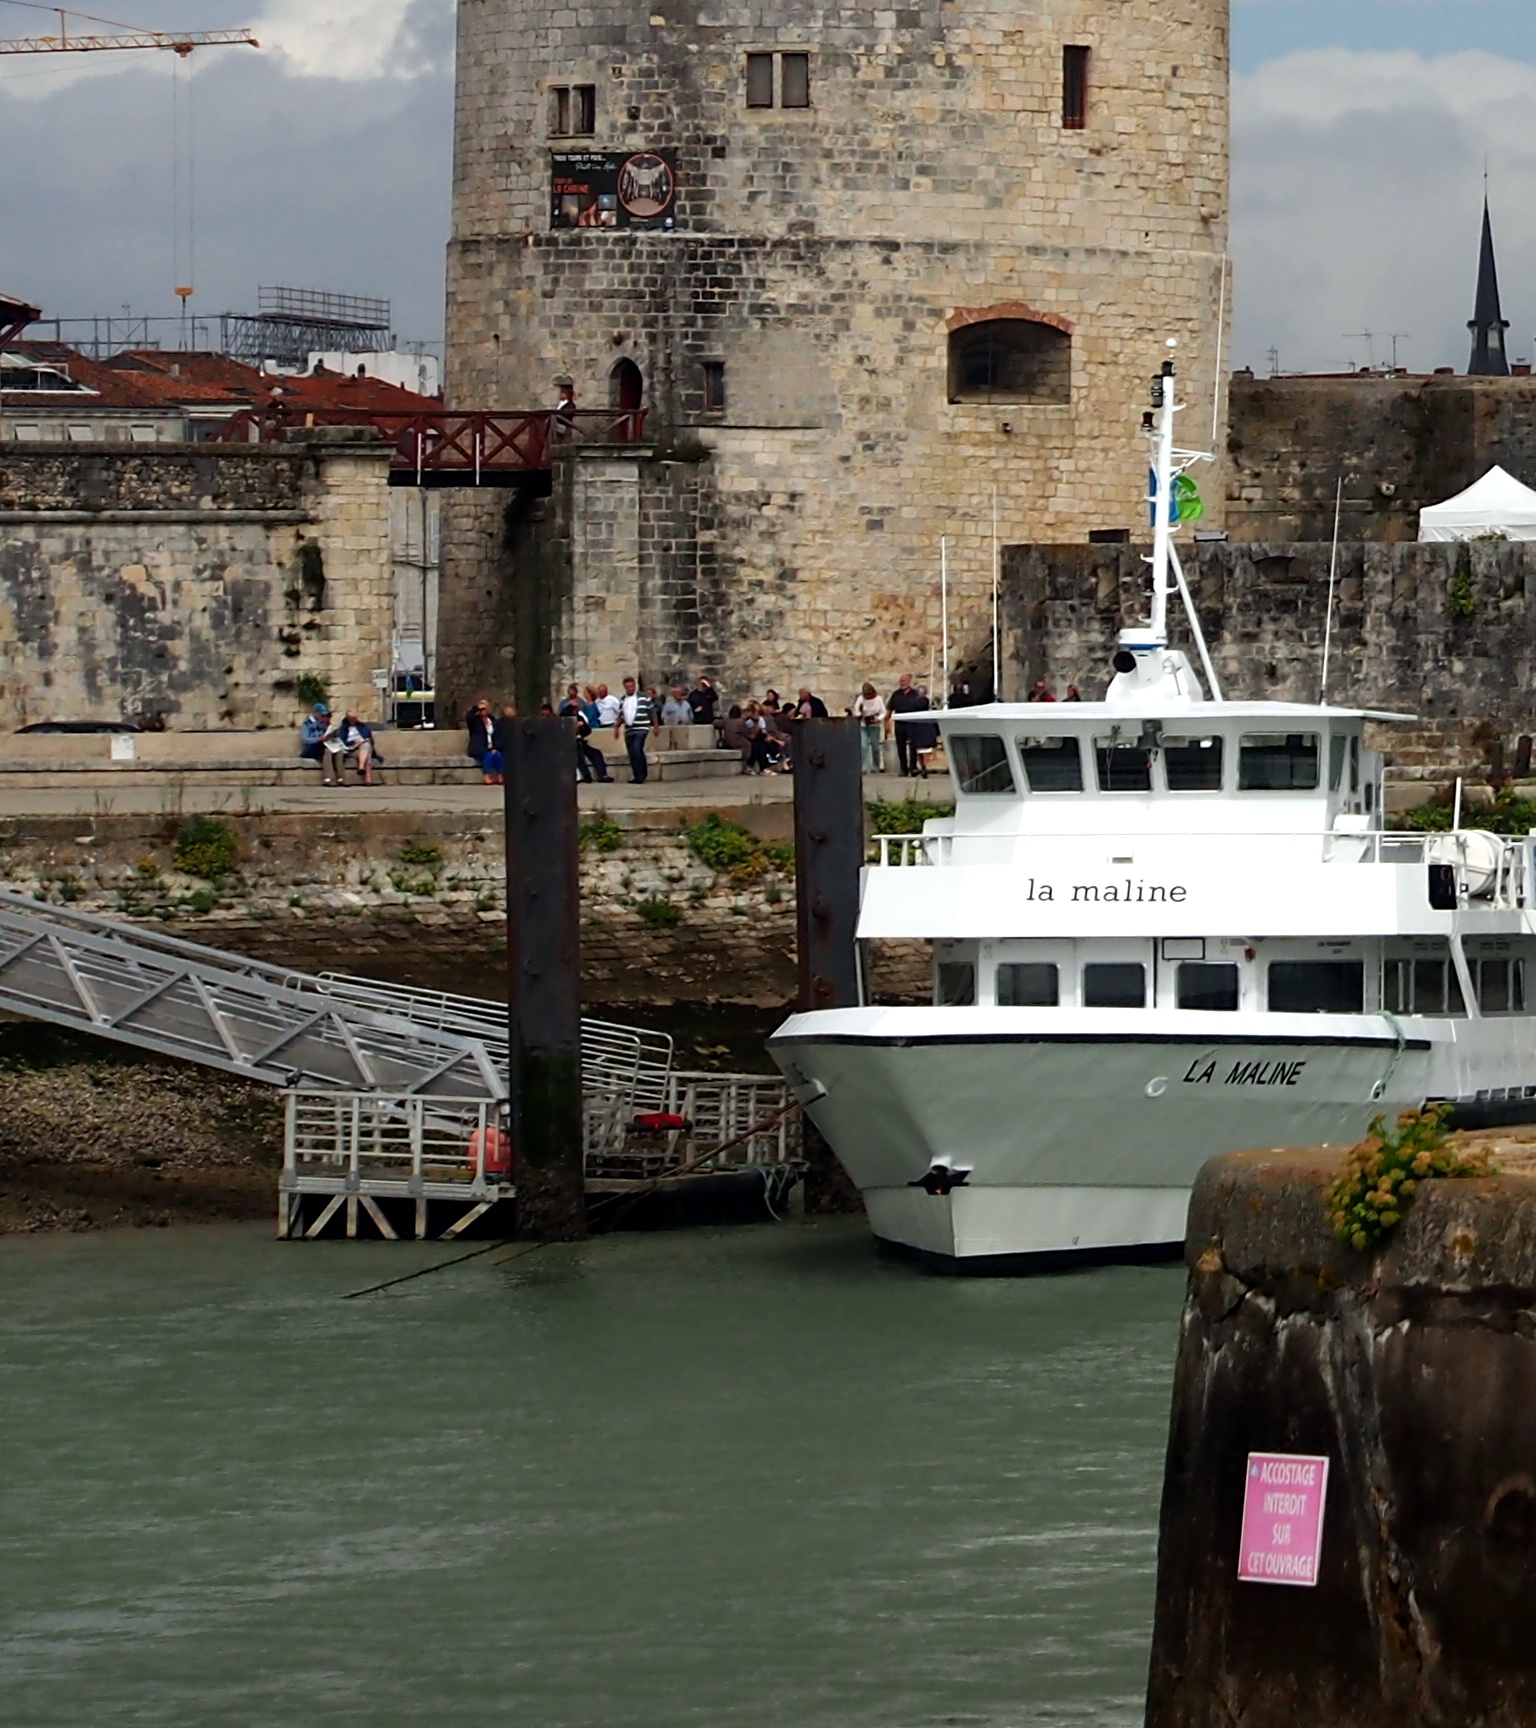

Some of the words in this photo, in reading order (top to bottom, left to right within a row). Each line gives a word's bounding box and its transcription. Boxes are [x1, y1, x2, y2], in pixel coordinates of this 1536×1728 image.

[1026, 878, 1054, 901] la
[1071, 878, 1187, 902] maline
[1183, 1059, 1217, 1083] LA
[1224, 1060, 1306, 1085] MALINE
[1260, 1461, 1316, 1486] ACCOSTAGE
[1264, 1493, 1307, 1514] INTERDIT
[1272, 1523, 1291, 1544] SUR
[1247, 1551, 1266, 1573] CET
[1265, 1553, 1315, 1578] OUVRAGE
